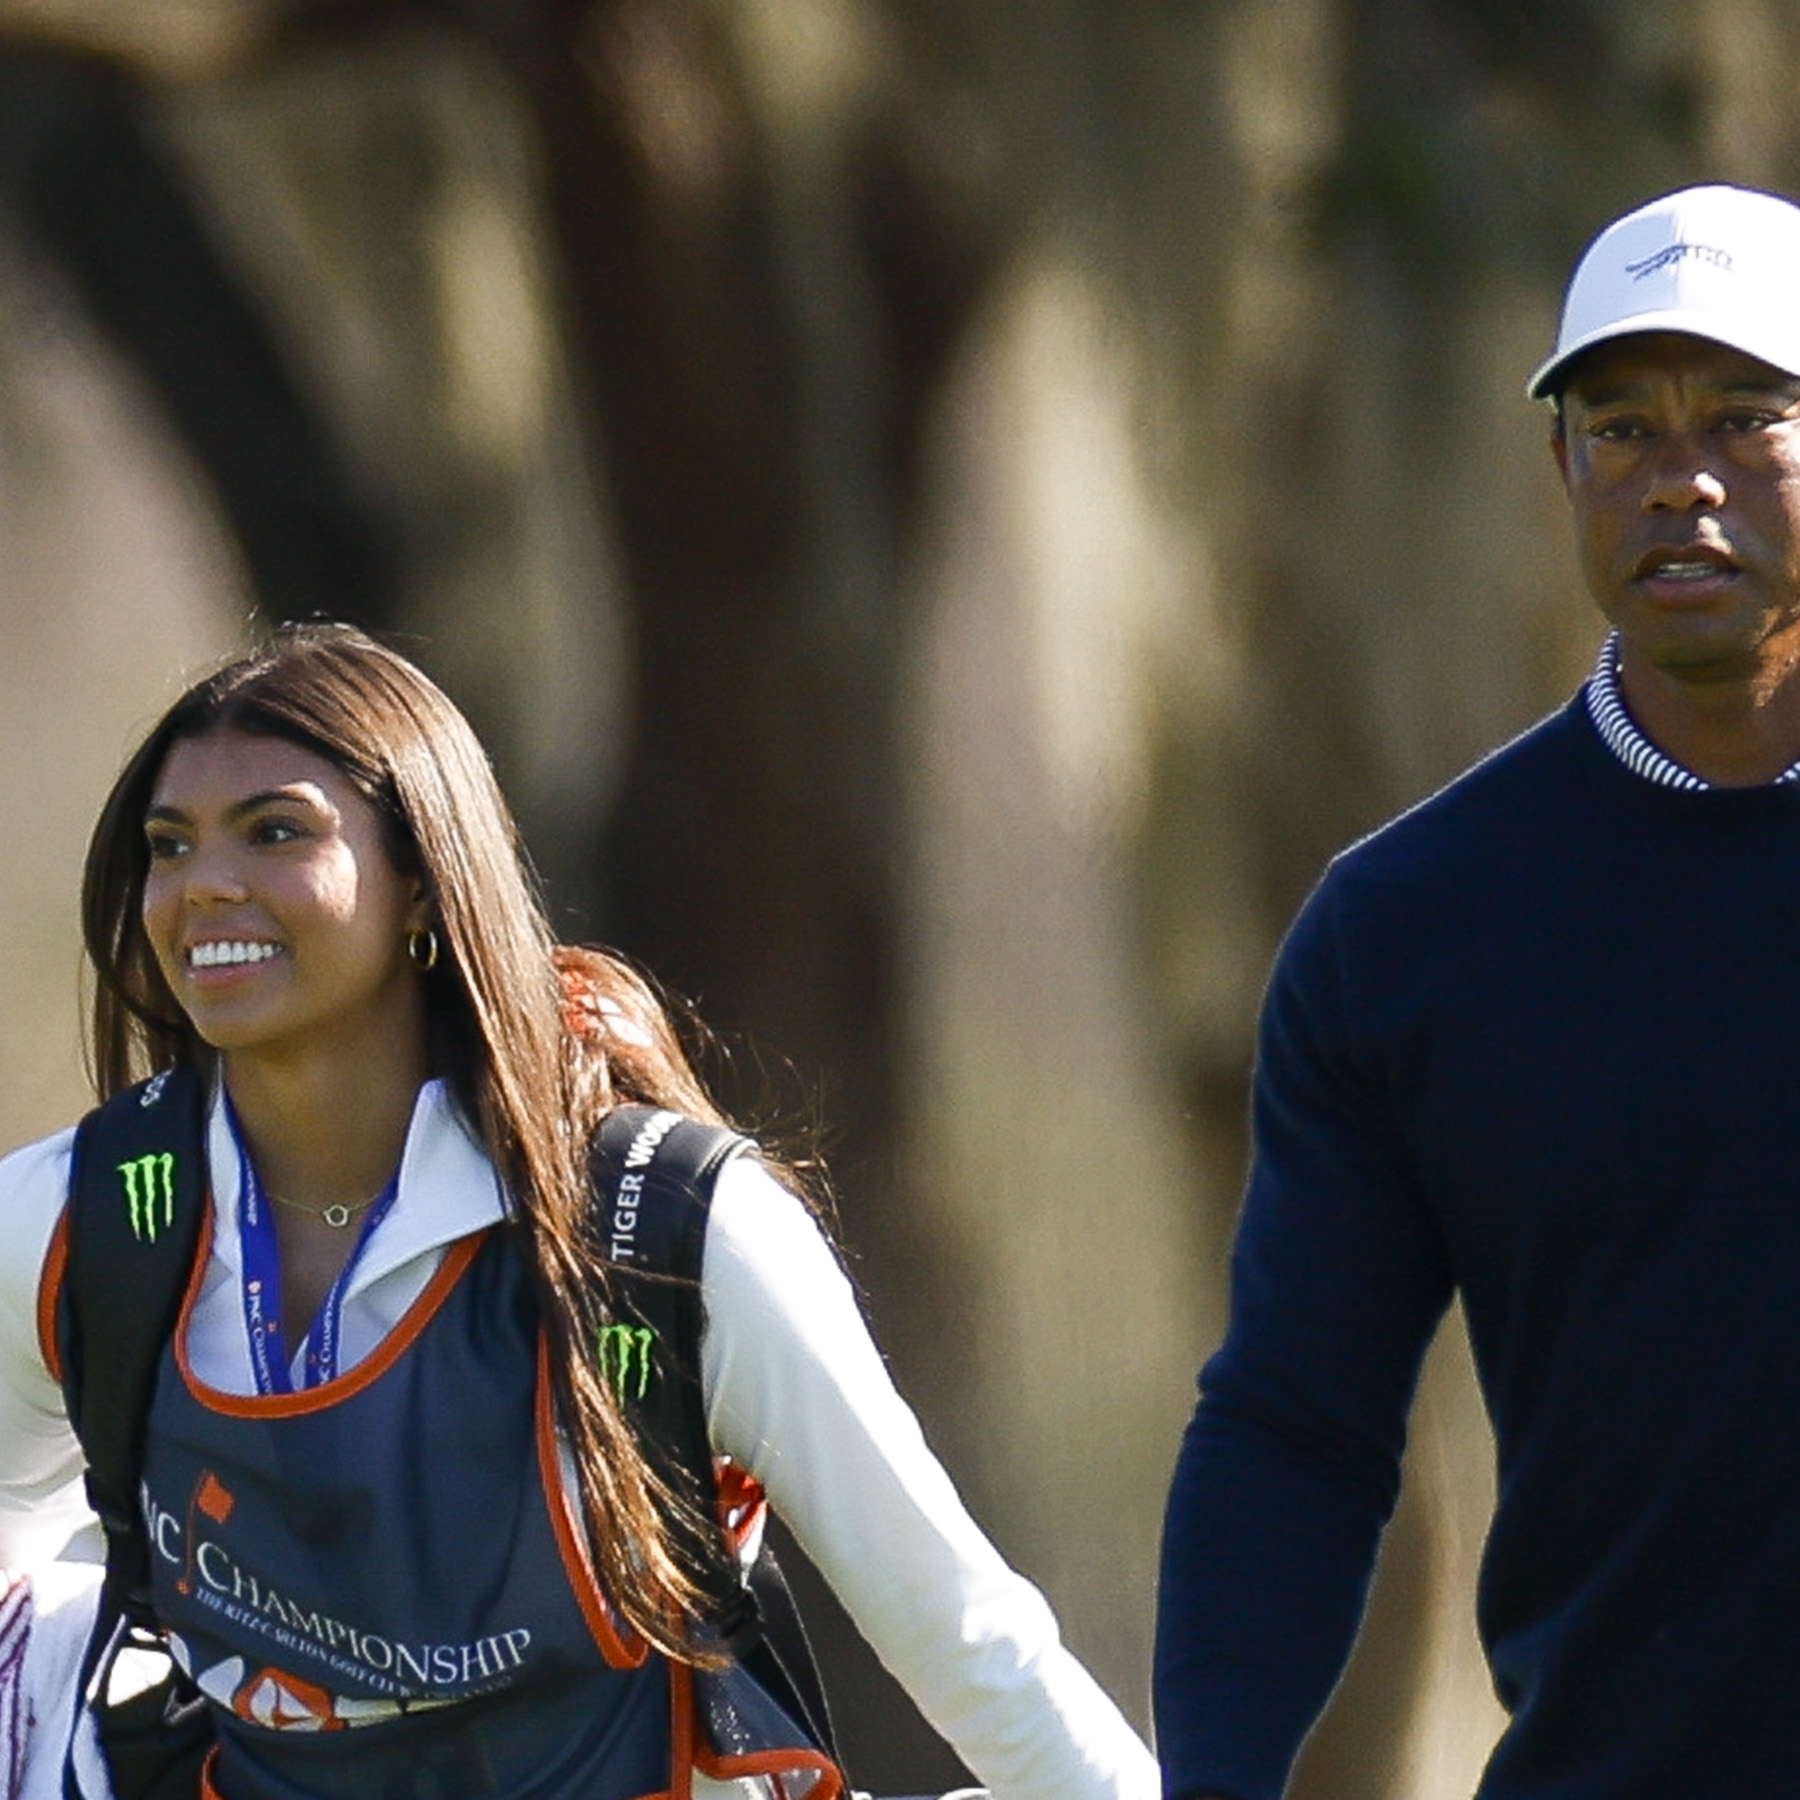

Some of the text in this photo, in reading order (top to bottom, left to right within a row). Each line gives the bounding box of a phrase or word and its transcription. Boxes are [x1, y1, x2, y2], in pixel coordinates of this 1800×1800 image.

[611, 1110, 684, 1262] TIGER WOO
[141, 1480, 532, 1684] NC CHAMPIONSHIP
